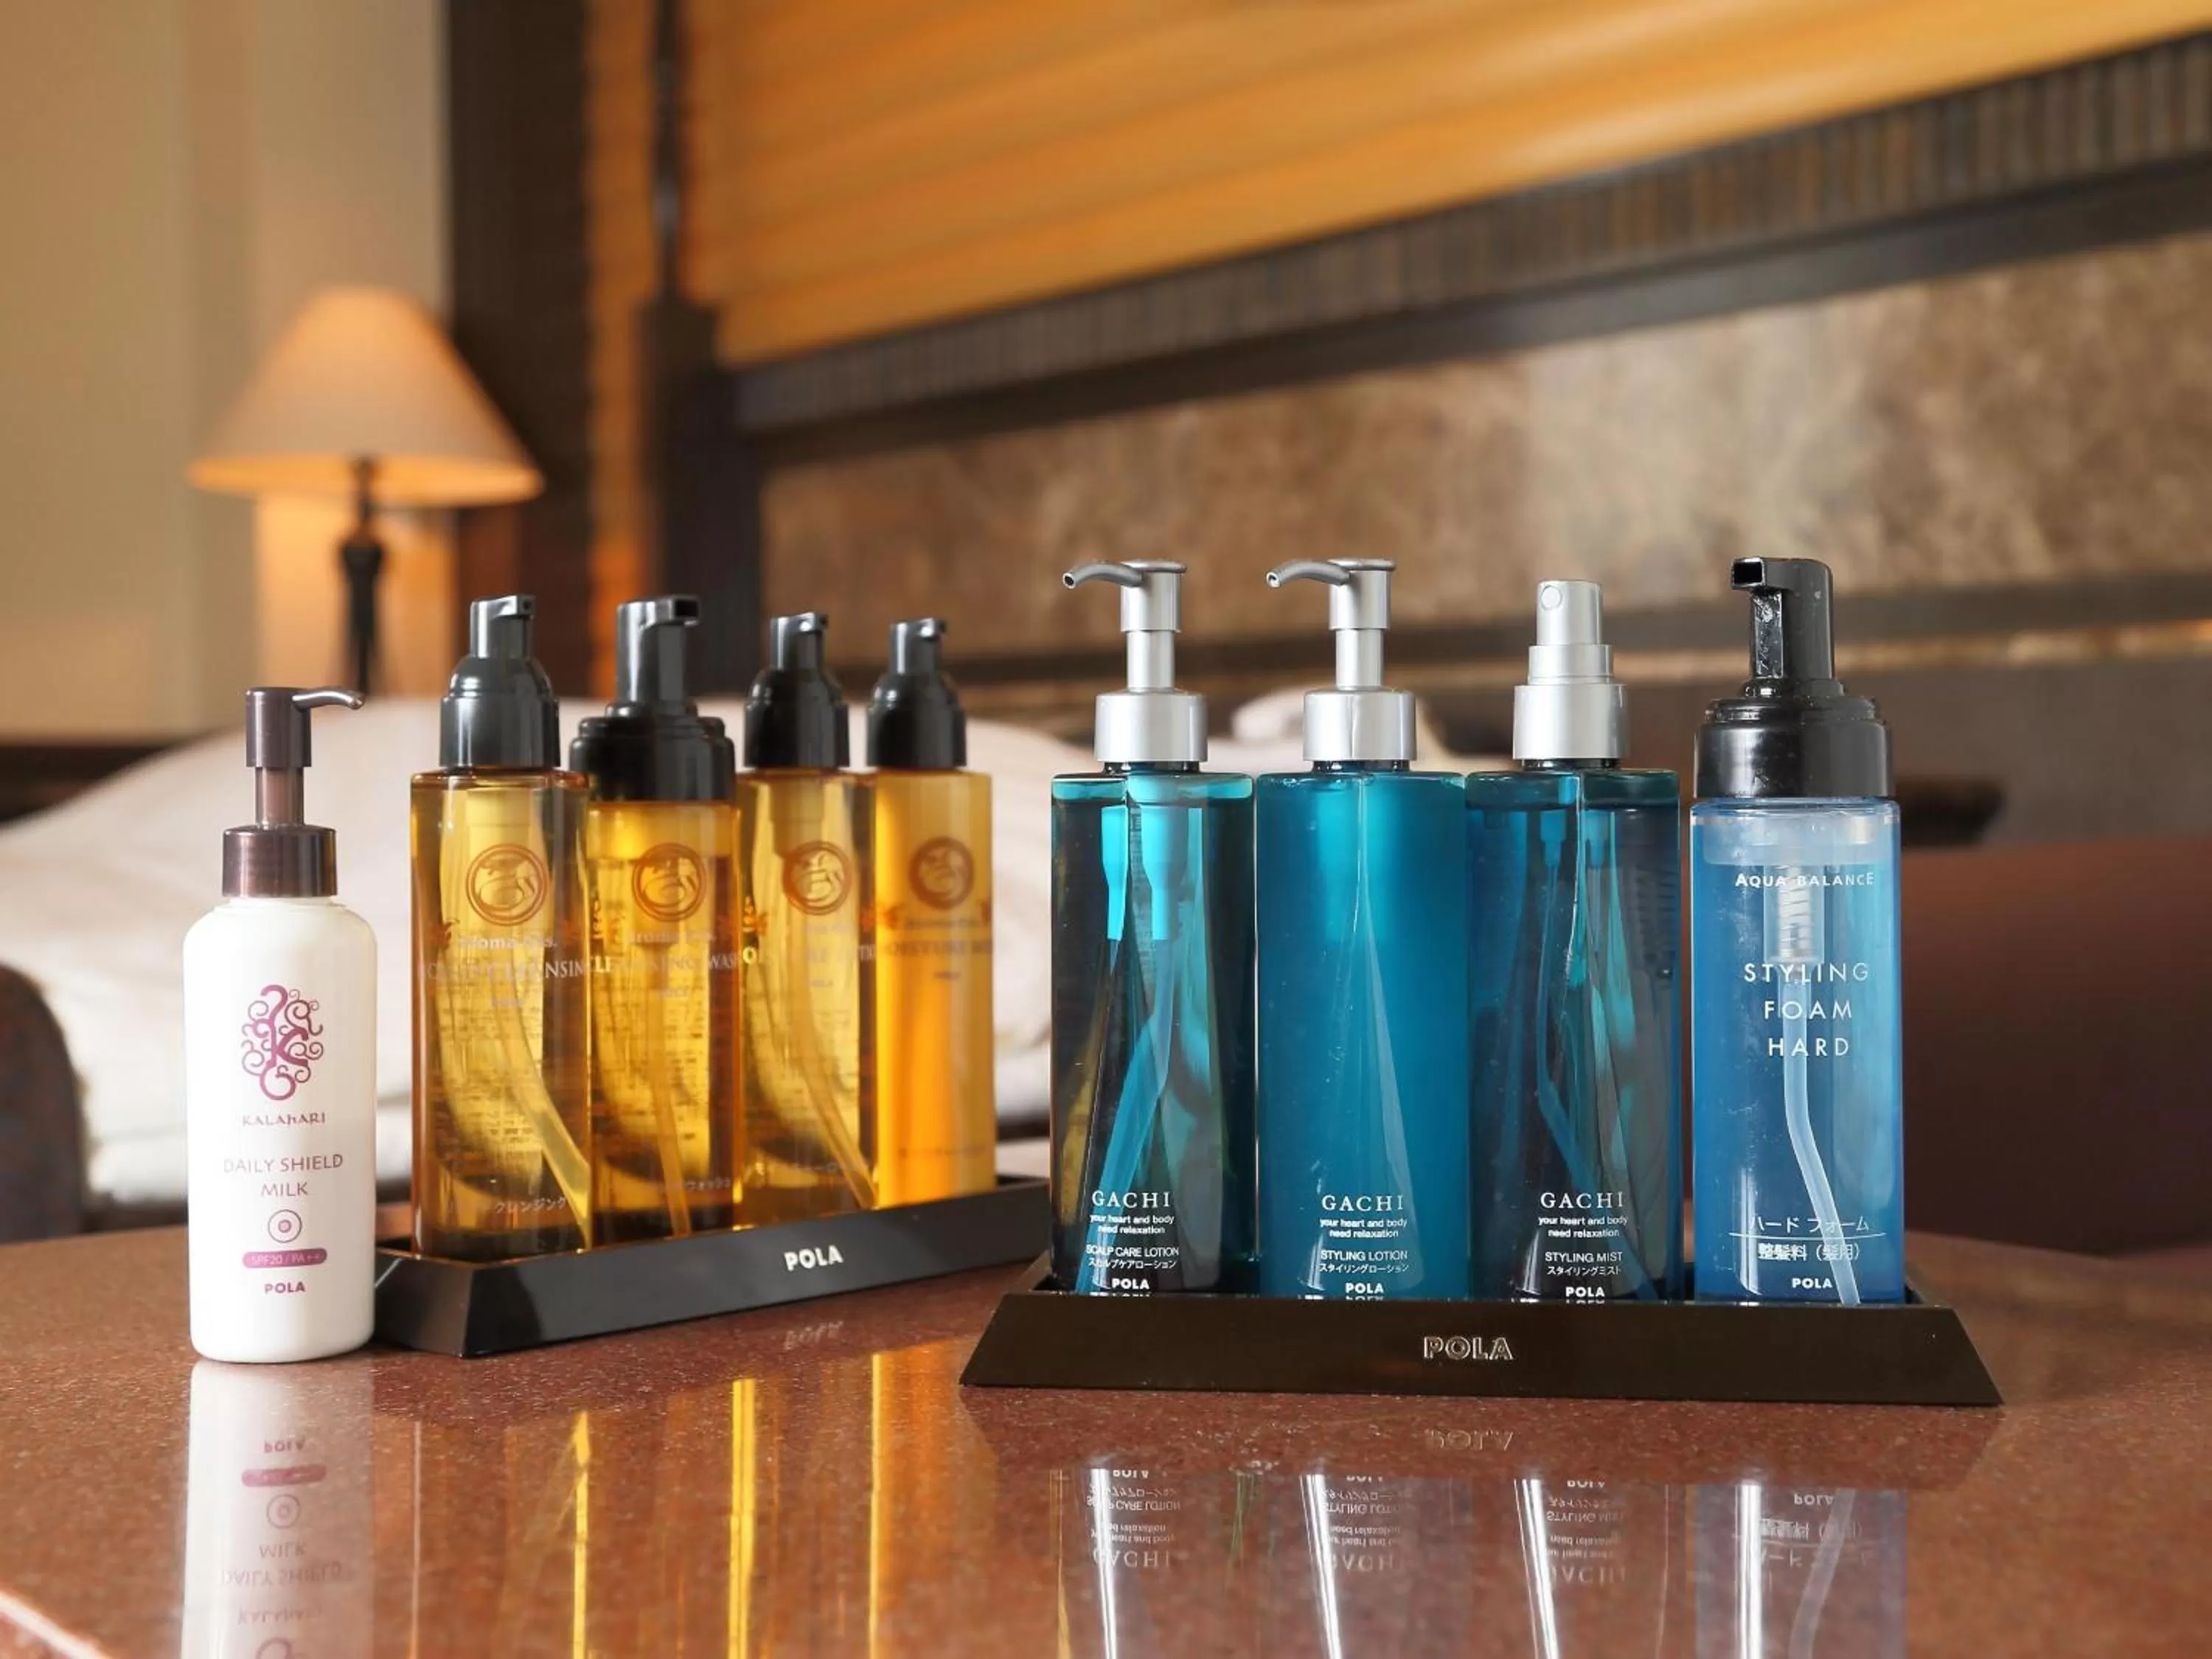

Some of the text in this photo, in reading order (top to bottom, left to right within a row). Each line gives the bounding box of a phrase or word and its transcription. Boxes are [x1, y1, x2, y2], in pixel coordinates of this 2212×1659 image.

[1735, 872, 1876, 887] AQUA BALANCE
[1744, 962, 1869, 984] STYLING
[1764, 1001, 1852, 1020] FOAM
[1768, 1037, 1848, 1057] HARD
[223, 1154, 344, 1175] DAILY SHIELD
[260, 1181, 308, 1197] MILK
[1091, 1190, 1171, 1208] GACHI
[1321, 1194, 1404, 1211] GACHI
[1540, 1191, 1624, 1208] GACHI
[1107, 1214, 1131, 1223] heart
[1133, 1216, 1150, 1224] and
[1152, 1214, 1175, 1225] body
[1319, 1217, 1408, 1228] your heart and body
[1538, 1215, 1628, 1225] your heart and body
[1097, 1225, 1166, 1234] need relaxation
[1329, 1229, 1399, 1238] need relaxation
[1548, 1228, 1620, 1238] need relaxation
[1085, 1244, 1179, 1257] SCALP CARE LOTION
[1321, 1249, 1408, 1261] STYLING LOTION
[784, 1244, 844, 1271] POLA
[1545, 1251, 1622, 1263] STYLING MIST
[1319, 1263, 1409, 1274] スタイリングローション
[1547, 1265, 1621, 1276] スタイリングミスト
[265, 1281, 306, 1294] POLA
[1112, 1278, 1150, 1290] POLA
[1346, 1282, 1384, 1294] POLA
[1792, 1278, 1833, 1289] POLA
[1565, 1287, 1605, 1298] POLA
[1423, 1335, 1514, 1360] POLA
